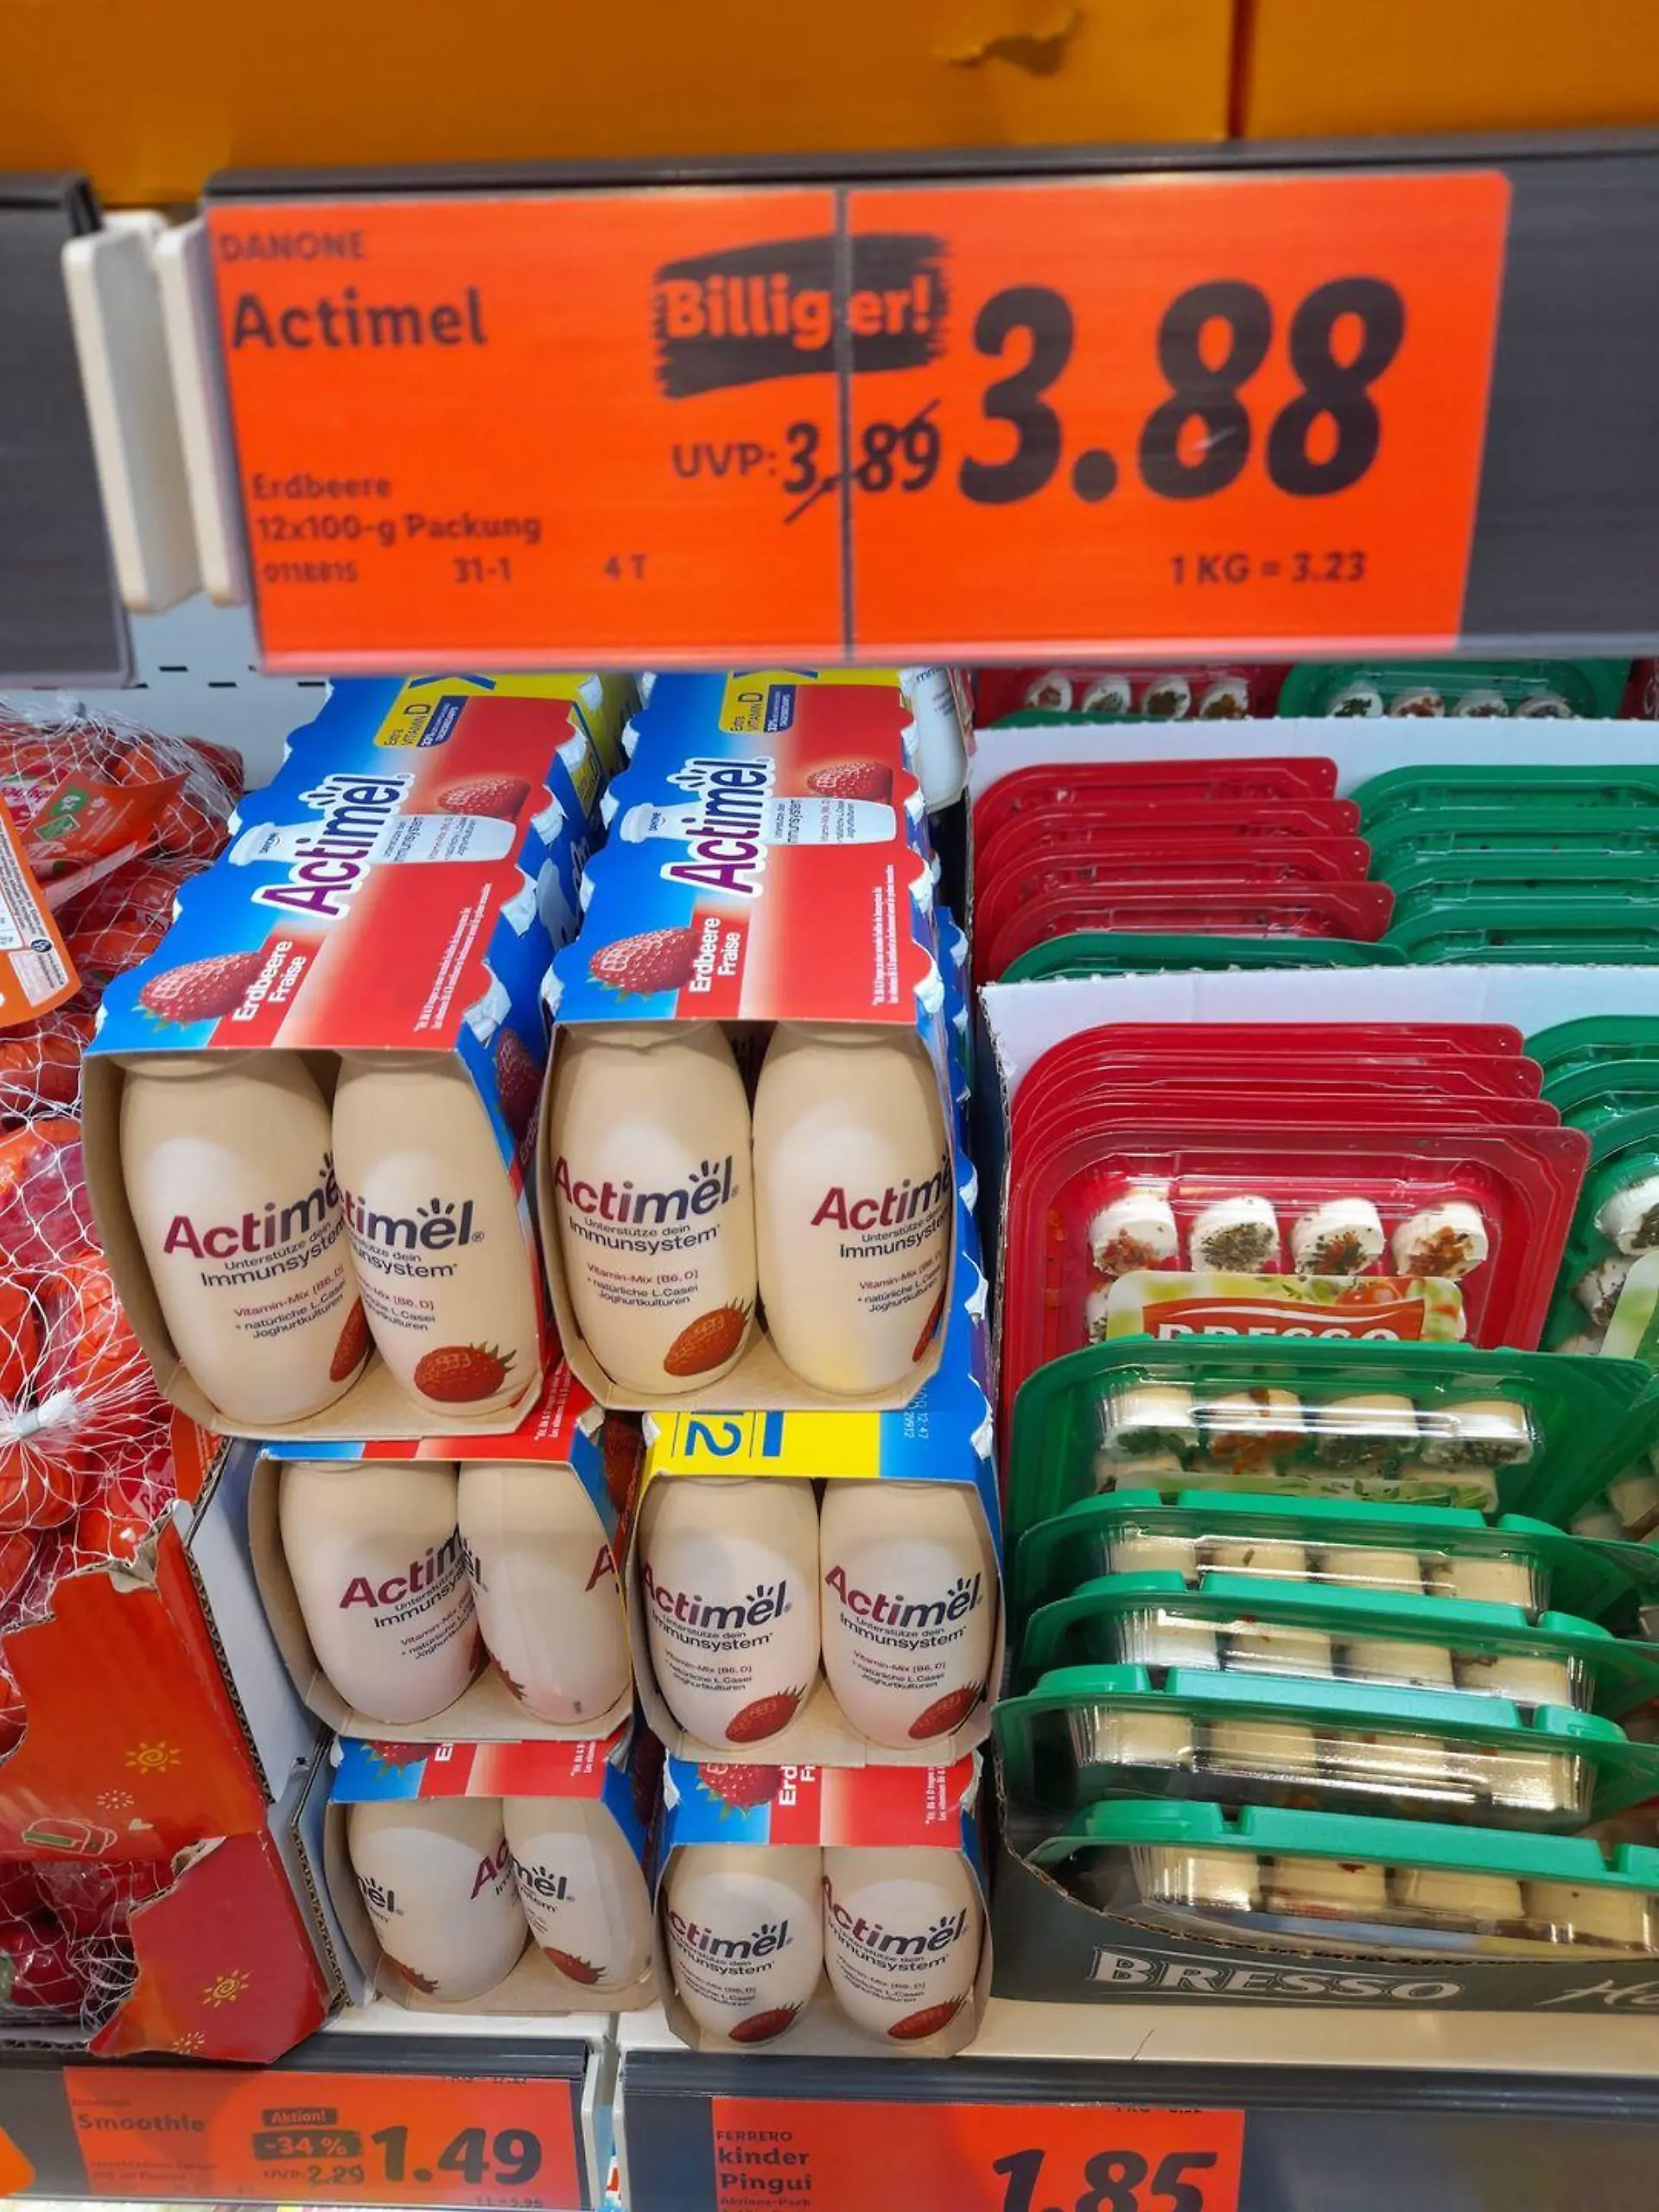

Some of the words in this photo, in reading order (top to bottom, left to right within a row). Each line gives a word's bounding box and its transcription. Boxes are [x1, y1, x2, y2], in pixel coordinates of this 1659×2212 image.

[218, 229, 365, 262] DANONE
[231, 286, 488, 351] Actimel
[958, 275, 1408, 506] 3.88
[671, 442, 778, 479] UVP:
[251, 474, 391, 499] Erdbeere
[258, 516, 396, 546] 12x100-g
[404, 514, 542, 544] Packung
[453, 557, 513, 582] 31-1
[603, 557, 623, 580] 4
[1172, 556, 1185, 585] 1
[1198, 553, 1250, 582] KG
[1291, 550, 1368, 582] 3.23
[261, 774, 406, 918] Actimel
[667, 760, 771, 893] Actimel
[690, 917, 721, 993] Erdbeere
[717, 932, 741, 977] Fraise
[232, 940, 294, 1022] Erdbeere
[268, 955, 307, 1004] Fraise
[163, 1153, 344, 1259] Actime
[554, 1154, 733, 1224] Actimel
[810, 1154, 951, 1230] Actime
[346, 1189, 474, 1250] timel
[584, 1217, 658, 1238] Unterstütze
[662, 1224, 691, 1237] dein
[225, 1240, 307, 1270] Unterstütze
[339, 1522, 463, 1609] Actim
[642, 1562, 787, 1630] Actimel
[824, 1565, 982, 1628] Actimel
[1091, 1948, 1463, 2001] BRESSO
[78, 2113, 205, 2133] Smoothie
[270, 2108, 327, 2124] Aktion!
[716, 2130, 793, 2142] FERRERO
[264, 2136, 315, 2156] -34
[321, 2136, 347, 2156] %
[370, 2124, 543, 2185] 1.49
[718, 2146, 810, 2165] kinder
[306, 2163, 365, 2186] 2.29
[721, 2172, 813, 2196] Pingui
